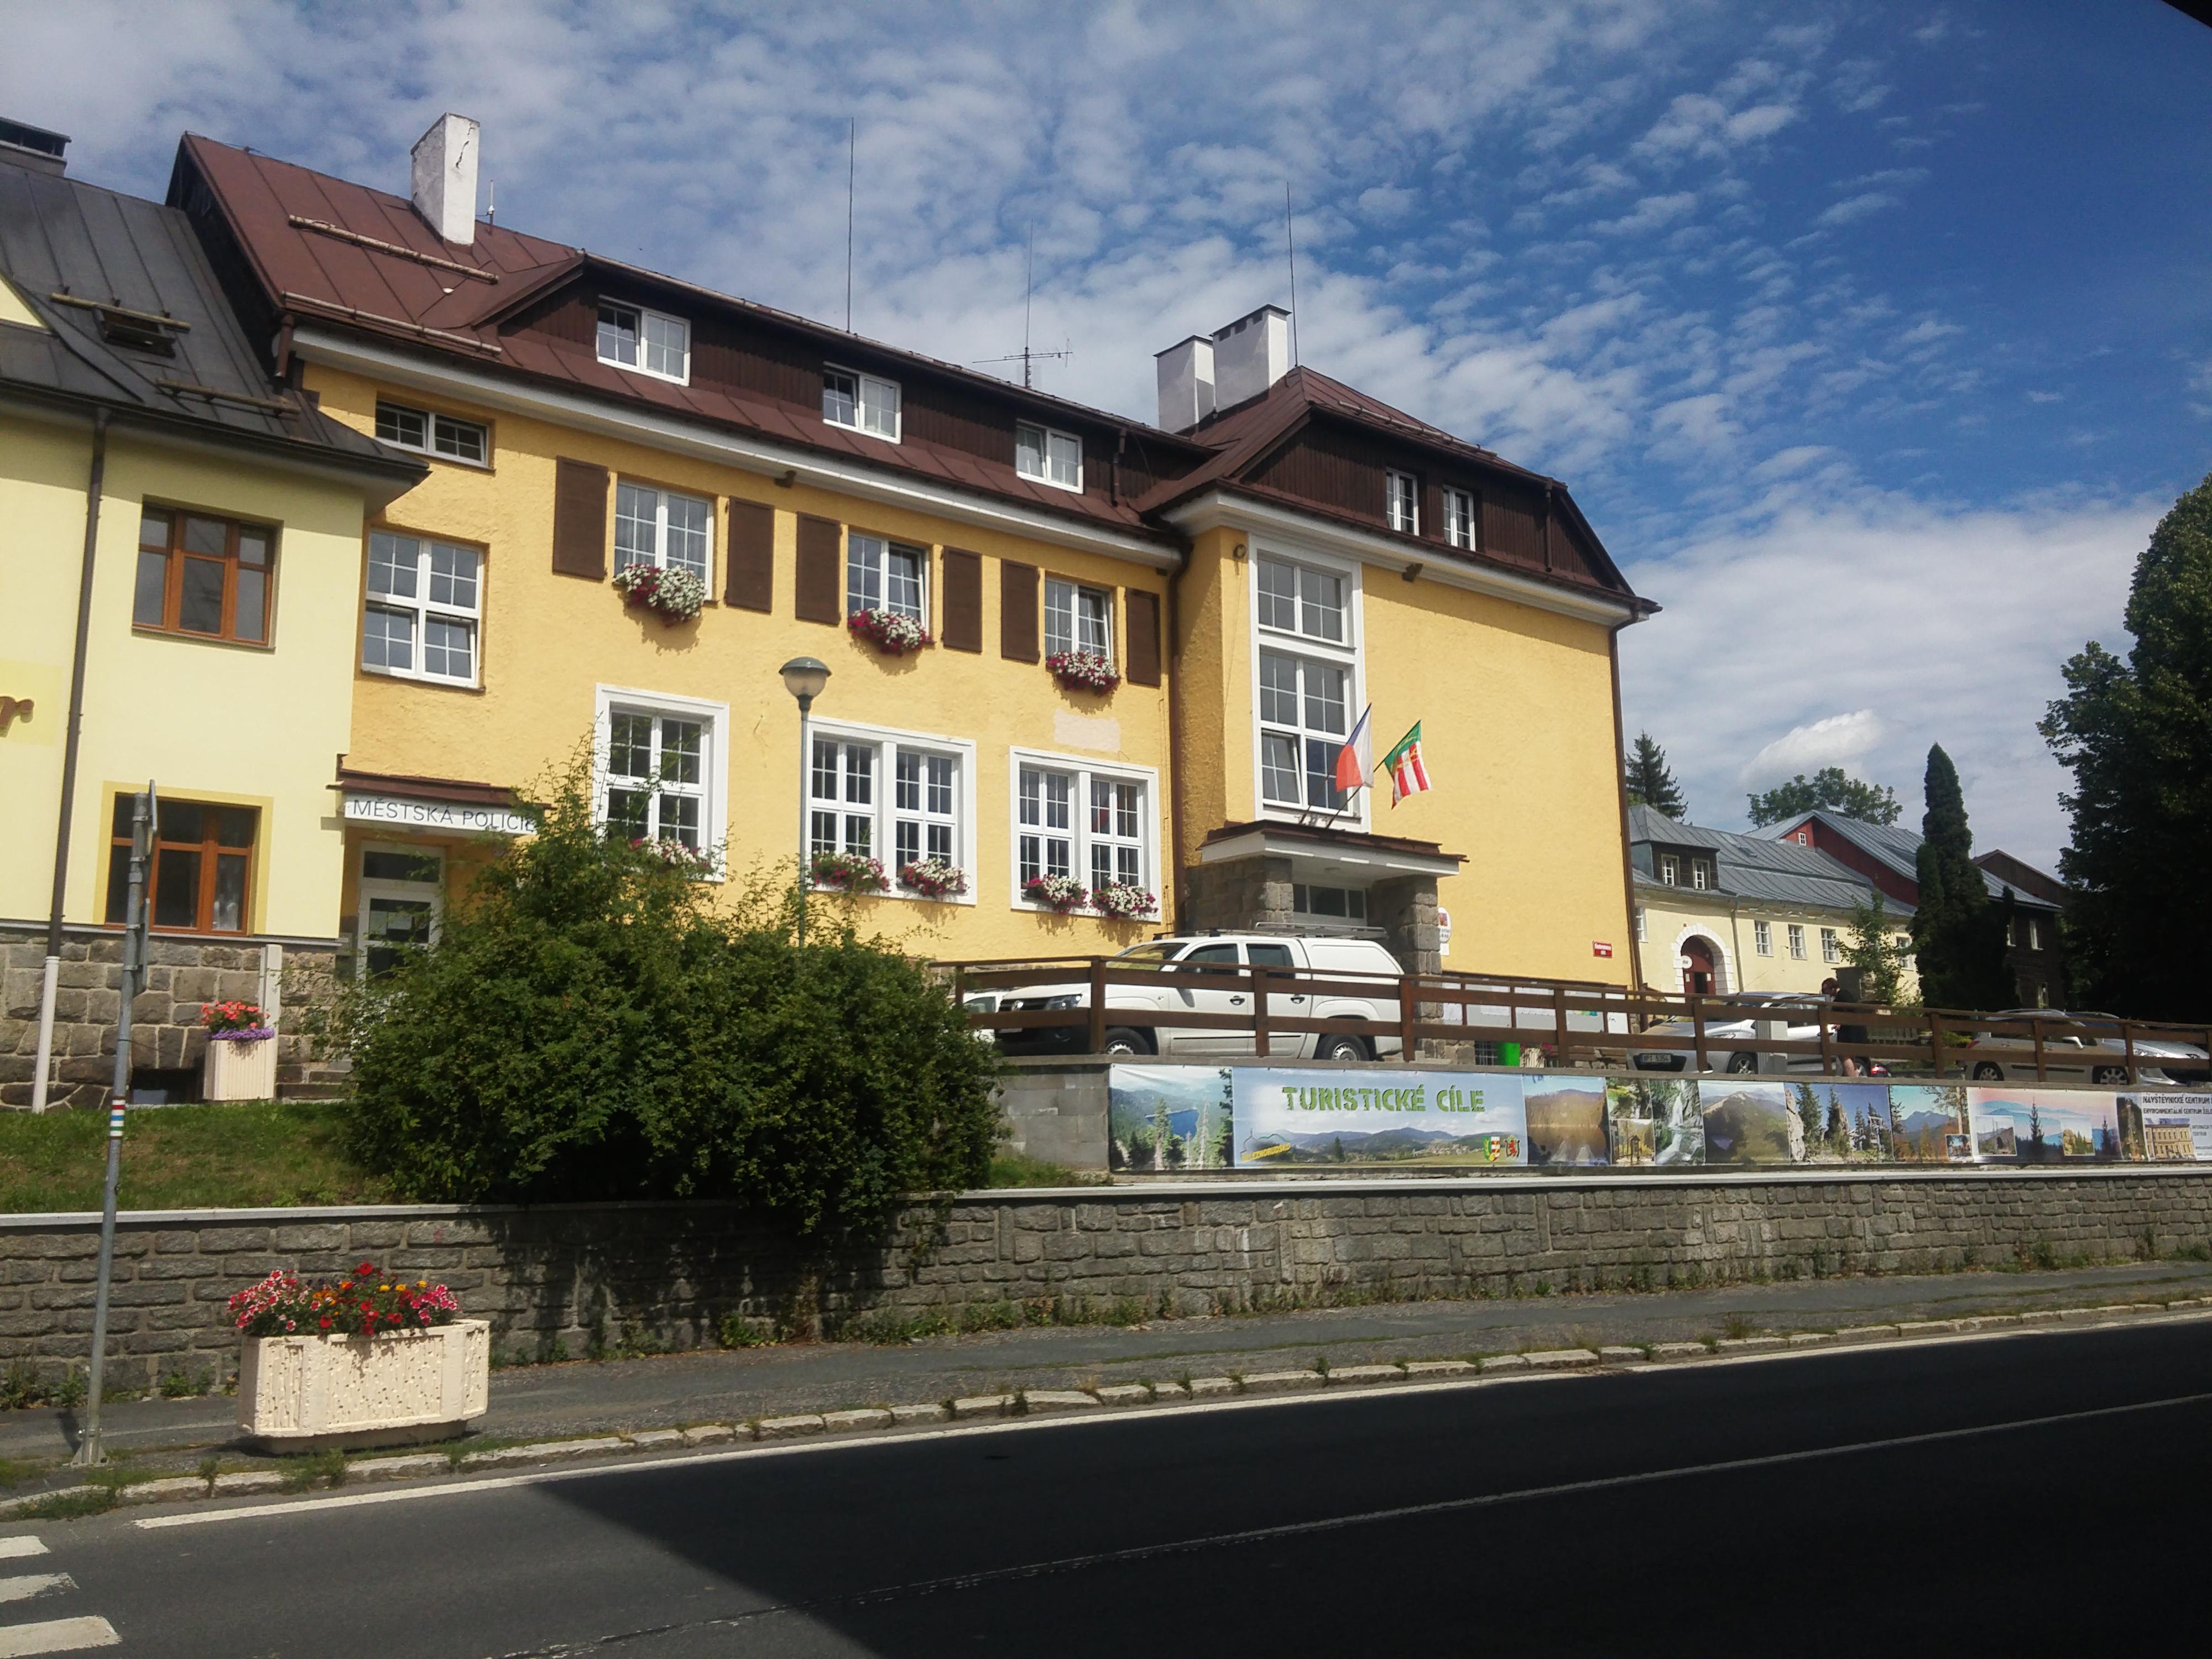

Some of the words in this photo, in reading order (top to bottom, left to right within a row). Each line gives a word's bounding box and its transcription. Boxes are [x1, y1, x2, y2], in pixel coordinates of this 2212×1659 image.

[353, 797, 453, 825] MĚSTSKÁ
[1282, 1084, 1426, 1112] TURISTICKÉ
[1436, 1084, 1485, 1112] CÍLE
[2185, 1096, 2210, 1104] CENTRUM
